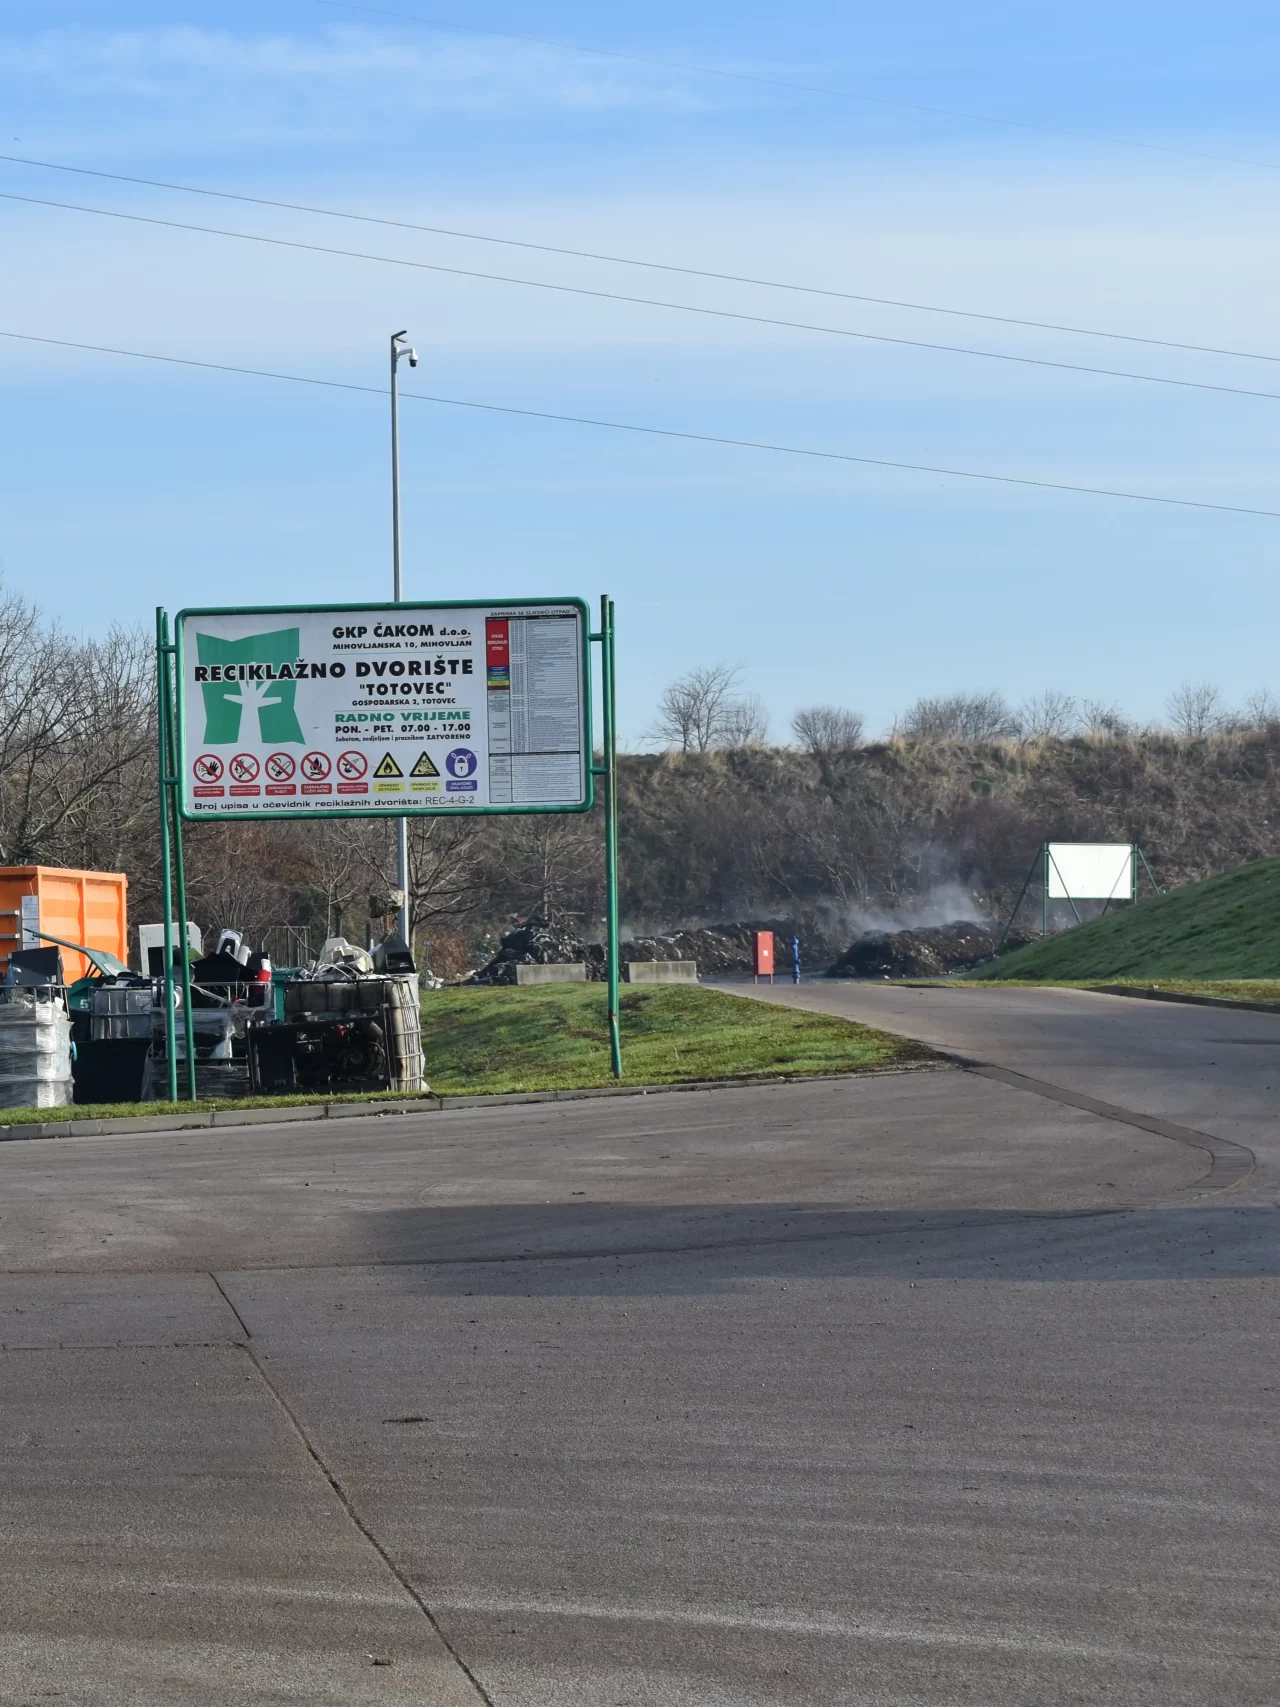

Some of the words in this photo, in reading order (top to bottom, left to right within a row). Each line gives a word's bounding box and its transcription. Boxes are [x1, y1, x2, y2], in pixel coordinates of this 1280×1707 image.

[332, 626, 368, 639] GKP
[373, 622, 435, 638] ČAKOM
[439, 627, 471, 636] d.o.o.
[332, 642, 401, 650] MIHOVLJANSKA
[404, 641, 418, 649] 10,
[420, 640, 472, 648] MIHOVLJAN
[194, 658, 346, 682] RECIKLAŽNO
[355, 654, 473, 678] DVORIŠTE
[359, 681, 452, 696] "TOTOVEC"
[352, 699, 410, 707] GOSPODARSKA
[412, 698, 420, 706] 2,
[422, 697, 456, 705] TOTOVEC
[334, 712, 395, 723] RADNO
[400, 711, 471, 721] VRIJEME
[334, 725, 362, 734] PON.
[373, 724, 394, 733] PET.
[400, 724, 431, 733] 07.00
[442, 723, 471, 732] 17.00
[194, 802, 217, 811] Broj
[220, 802, 249, 810] upisa
[262, 800, 311, 808] očevidnik
[315, 799, 371, 807] reciklažnih
[374, 798, 422, 806] dvorišta:
[425, 796, 475, 805] REC-4-G-2
